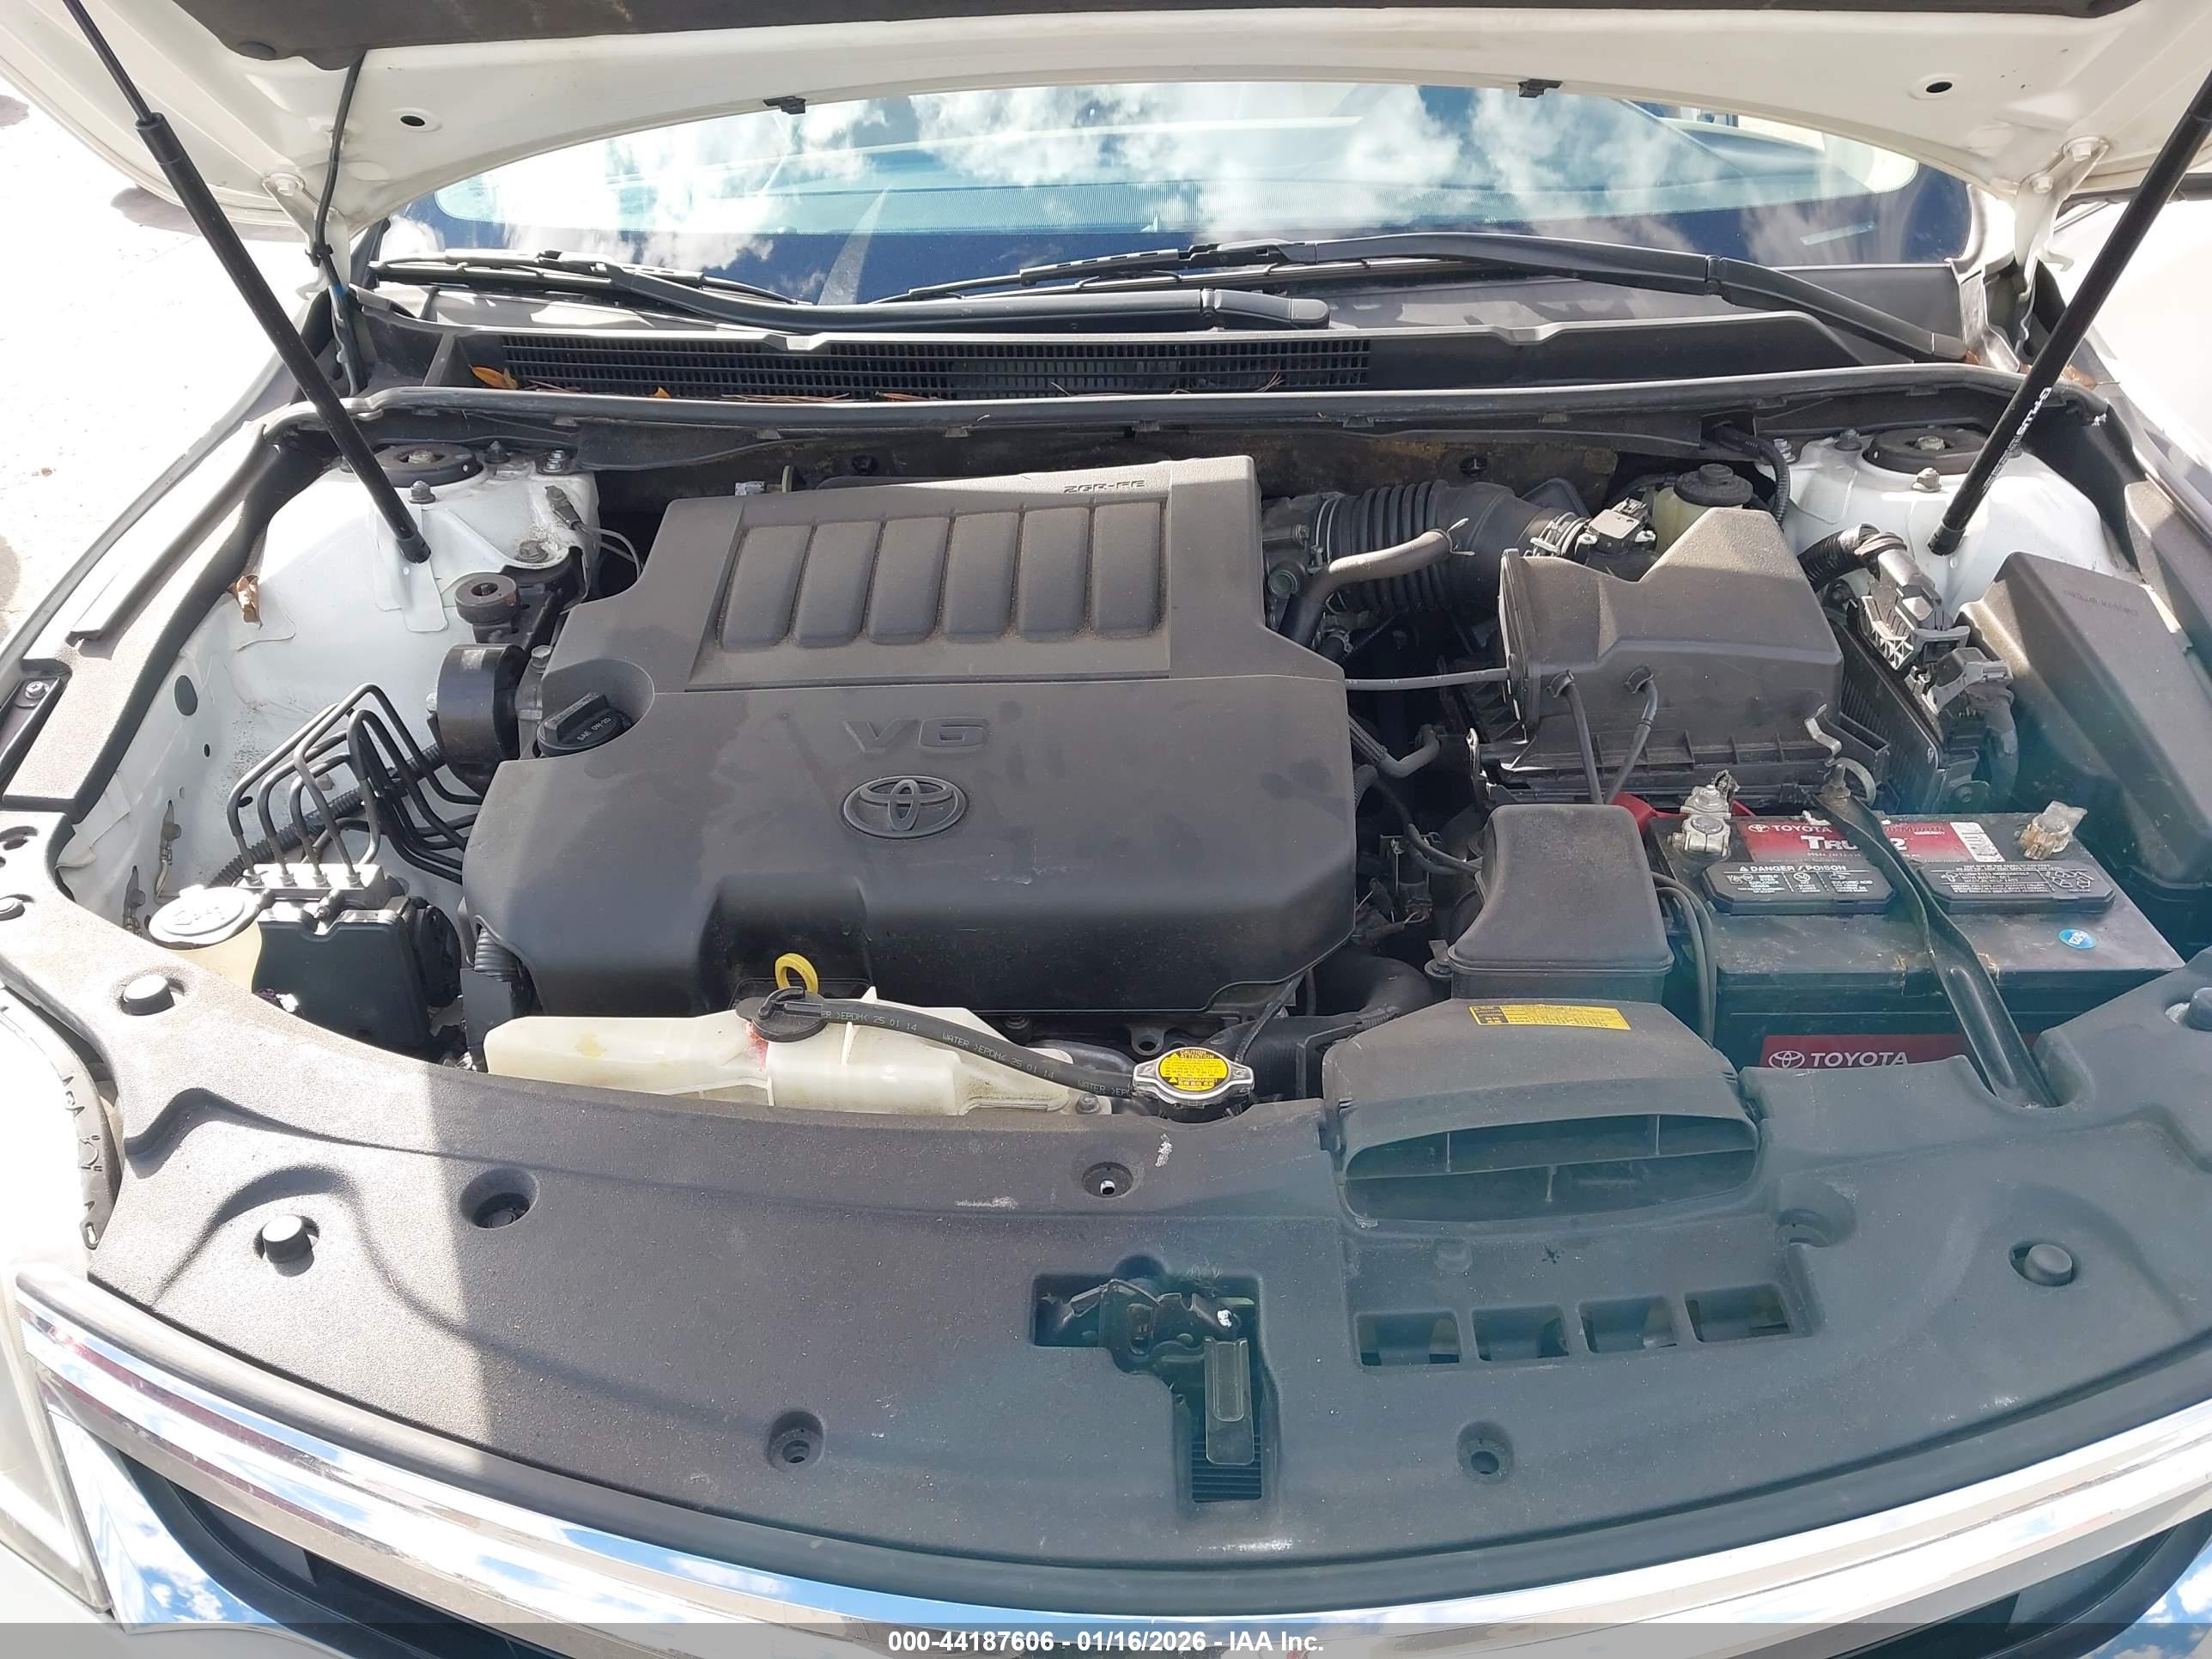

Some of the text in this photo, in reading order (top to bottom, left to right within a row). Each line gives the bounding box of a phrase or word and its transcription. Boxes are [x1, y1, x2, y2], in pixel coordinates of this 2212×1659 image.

[1064, 479, 1145, 493] 2GR-FE
[576, 730, 592, 741] SAE
[843, 715, 988, 754] V6
[1771, 824, 1832, 833] TOYOTA
[890, 1019, 899, 1028] 01
[942, 1032, 969, 1048] WATER
[1011, 1057, 1023, 1067] 25
[1026, 1064, 1037, 1073] 01
[1043, 1070, 1054, 1079] 14
[1810, 1051, 1909, 1067] TOYOTA
[1078, 1079, 1106, 1094] WATER
